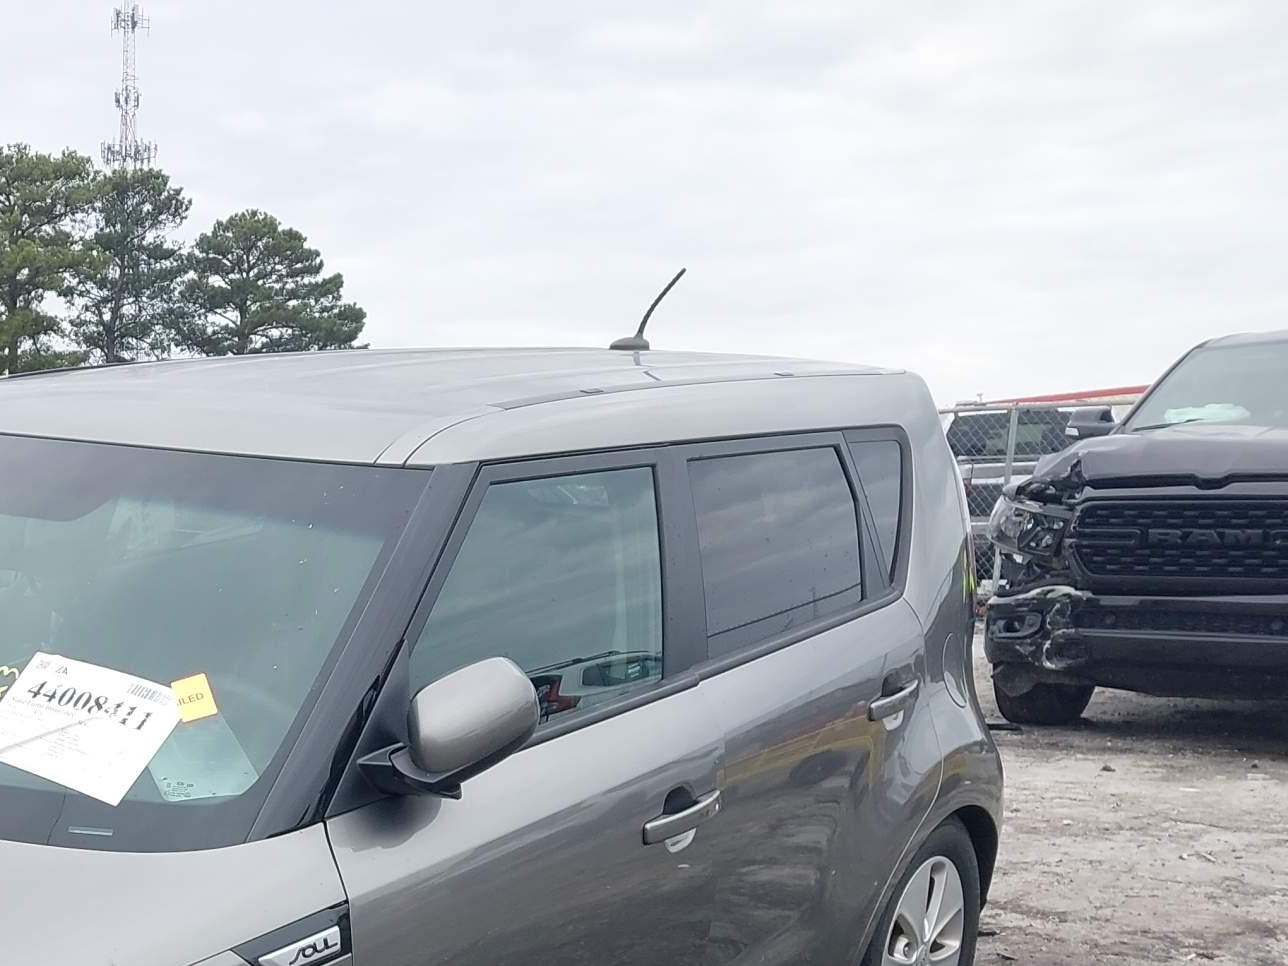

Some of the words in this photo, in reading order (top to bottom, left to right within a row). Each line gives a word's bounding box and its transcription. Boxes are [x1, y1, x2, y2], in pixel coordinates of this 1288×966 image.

[1147, 527, 1264, 546] RAM
[177, 691, 205, 707] ILED
[288, 936, 339, 966] SOUL
